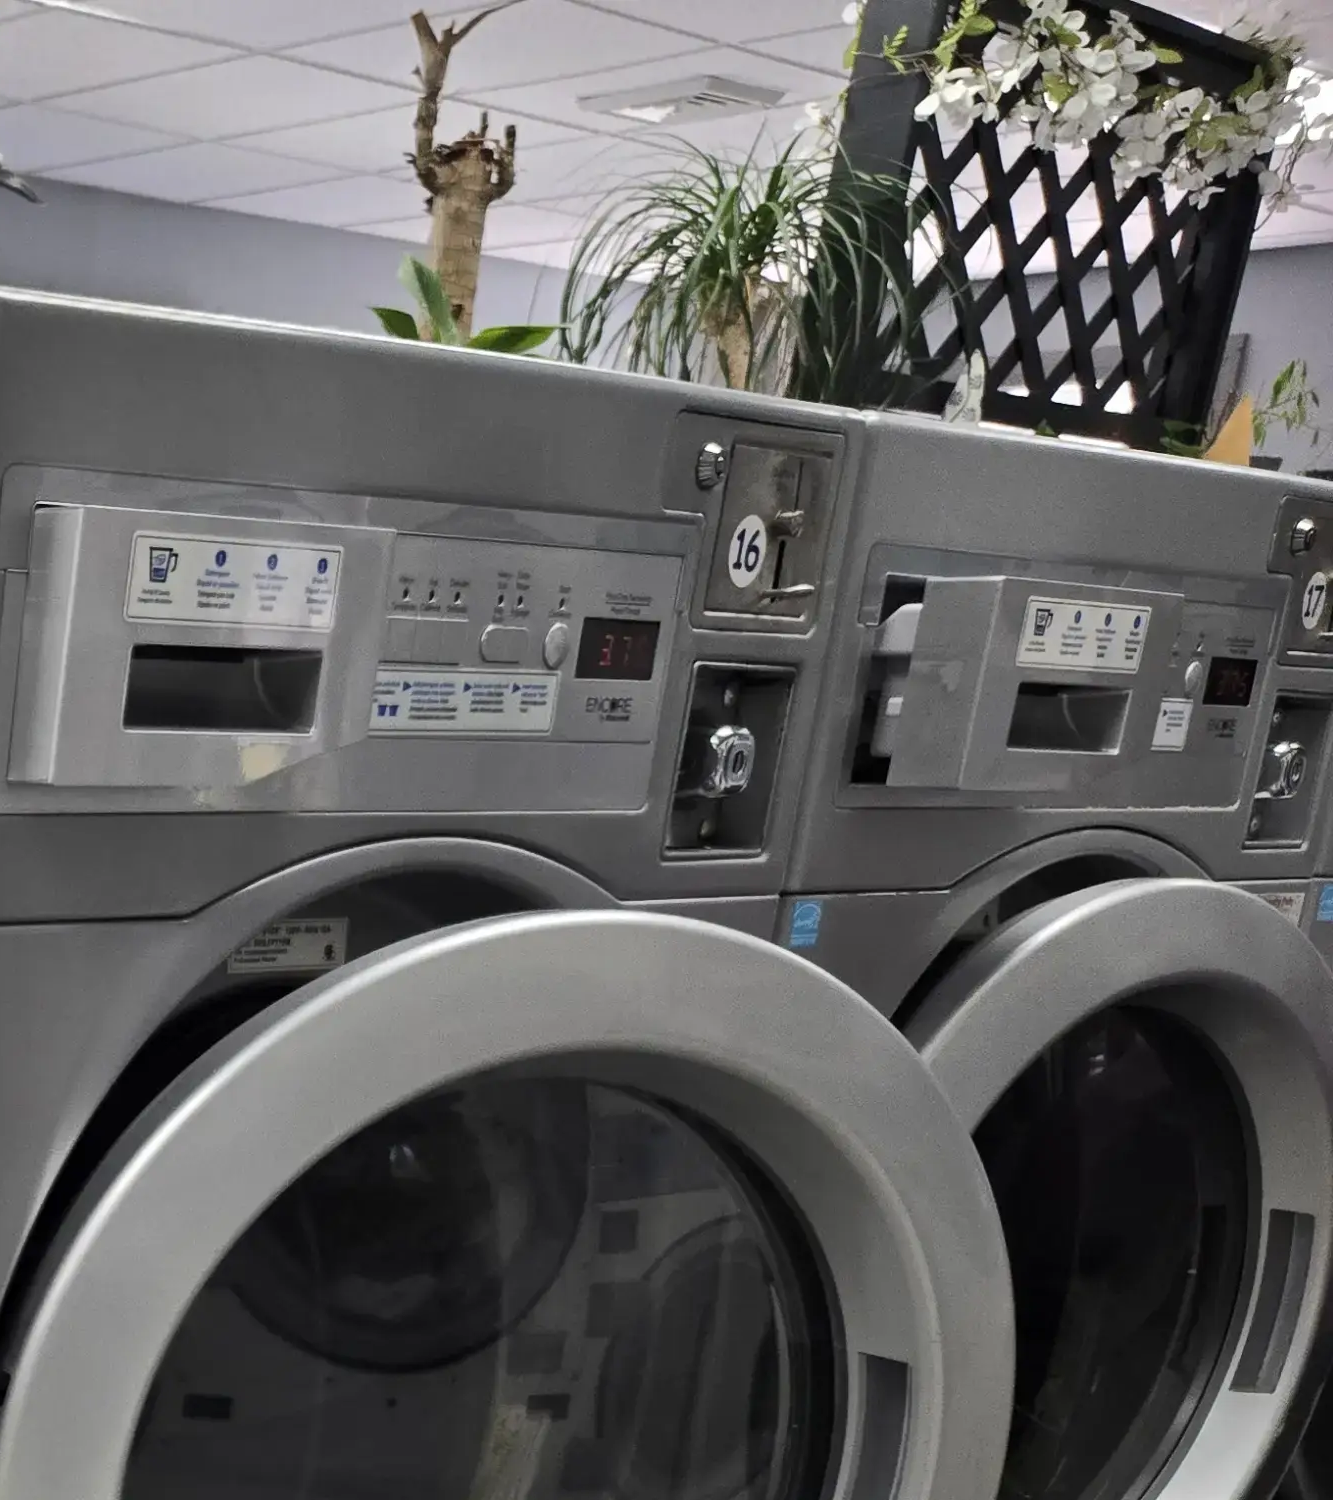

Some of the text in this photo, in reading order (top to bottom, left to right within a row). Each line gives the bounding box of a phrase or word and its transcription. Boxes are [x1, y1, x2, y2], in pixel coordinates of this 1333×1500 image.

[732, 528, 760, 572] 16
[1304, 584, 1325, 618] 17
[585, 697, 634, 713] ENCORE
